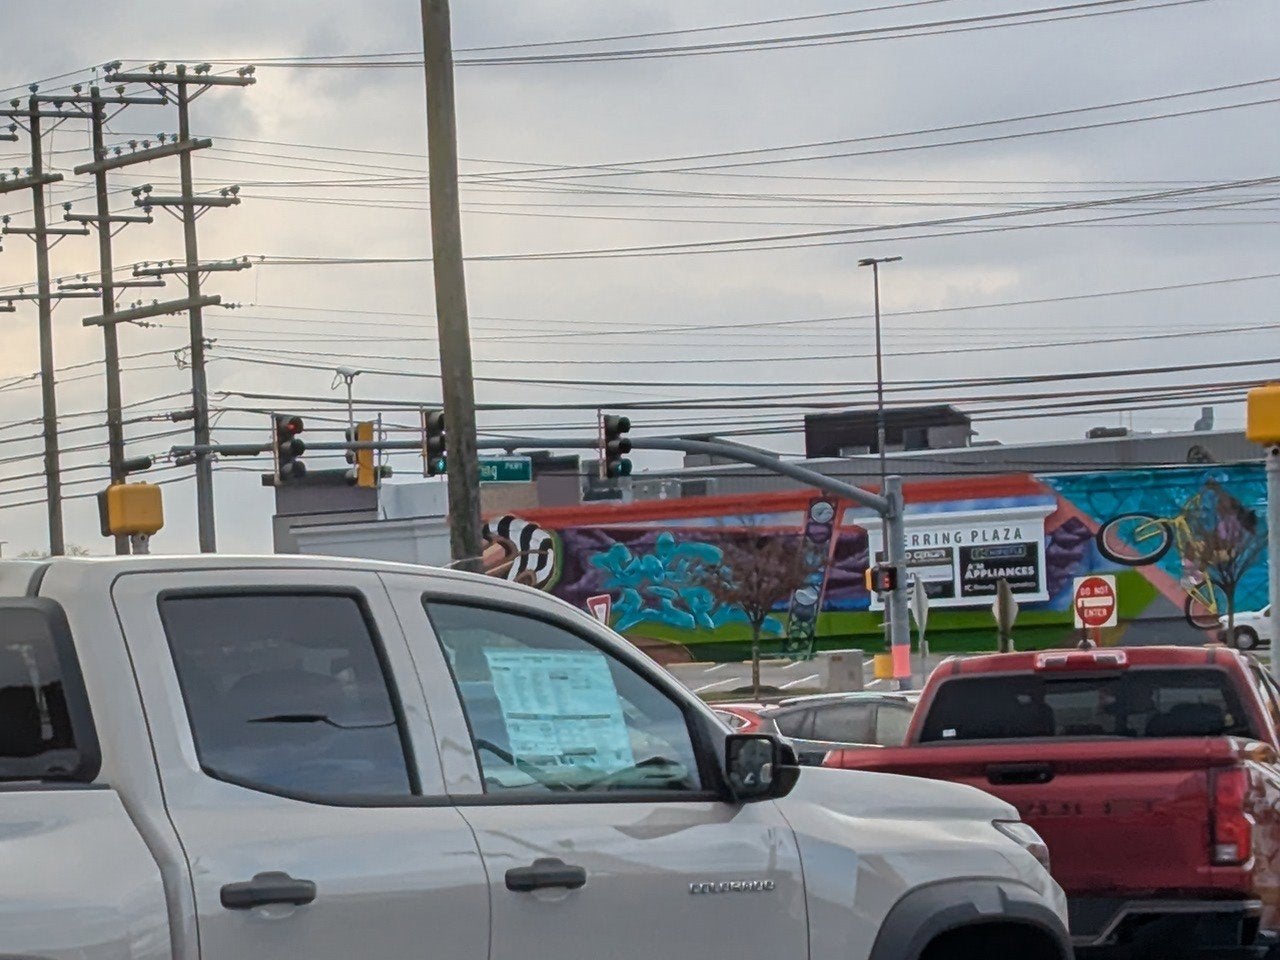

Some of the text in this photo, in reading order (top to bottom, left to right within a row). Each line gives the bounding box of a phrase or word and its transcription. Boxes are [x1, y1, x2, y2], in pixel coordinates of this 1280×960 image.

[904, 528, 1022, 547] ERRING PLAZA
[965, 565, 1035, 580] APPLIANCES
[1080, 587, 1090, 596] DO
[1084, 608, 1107, 618] ENTER
